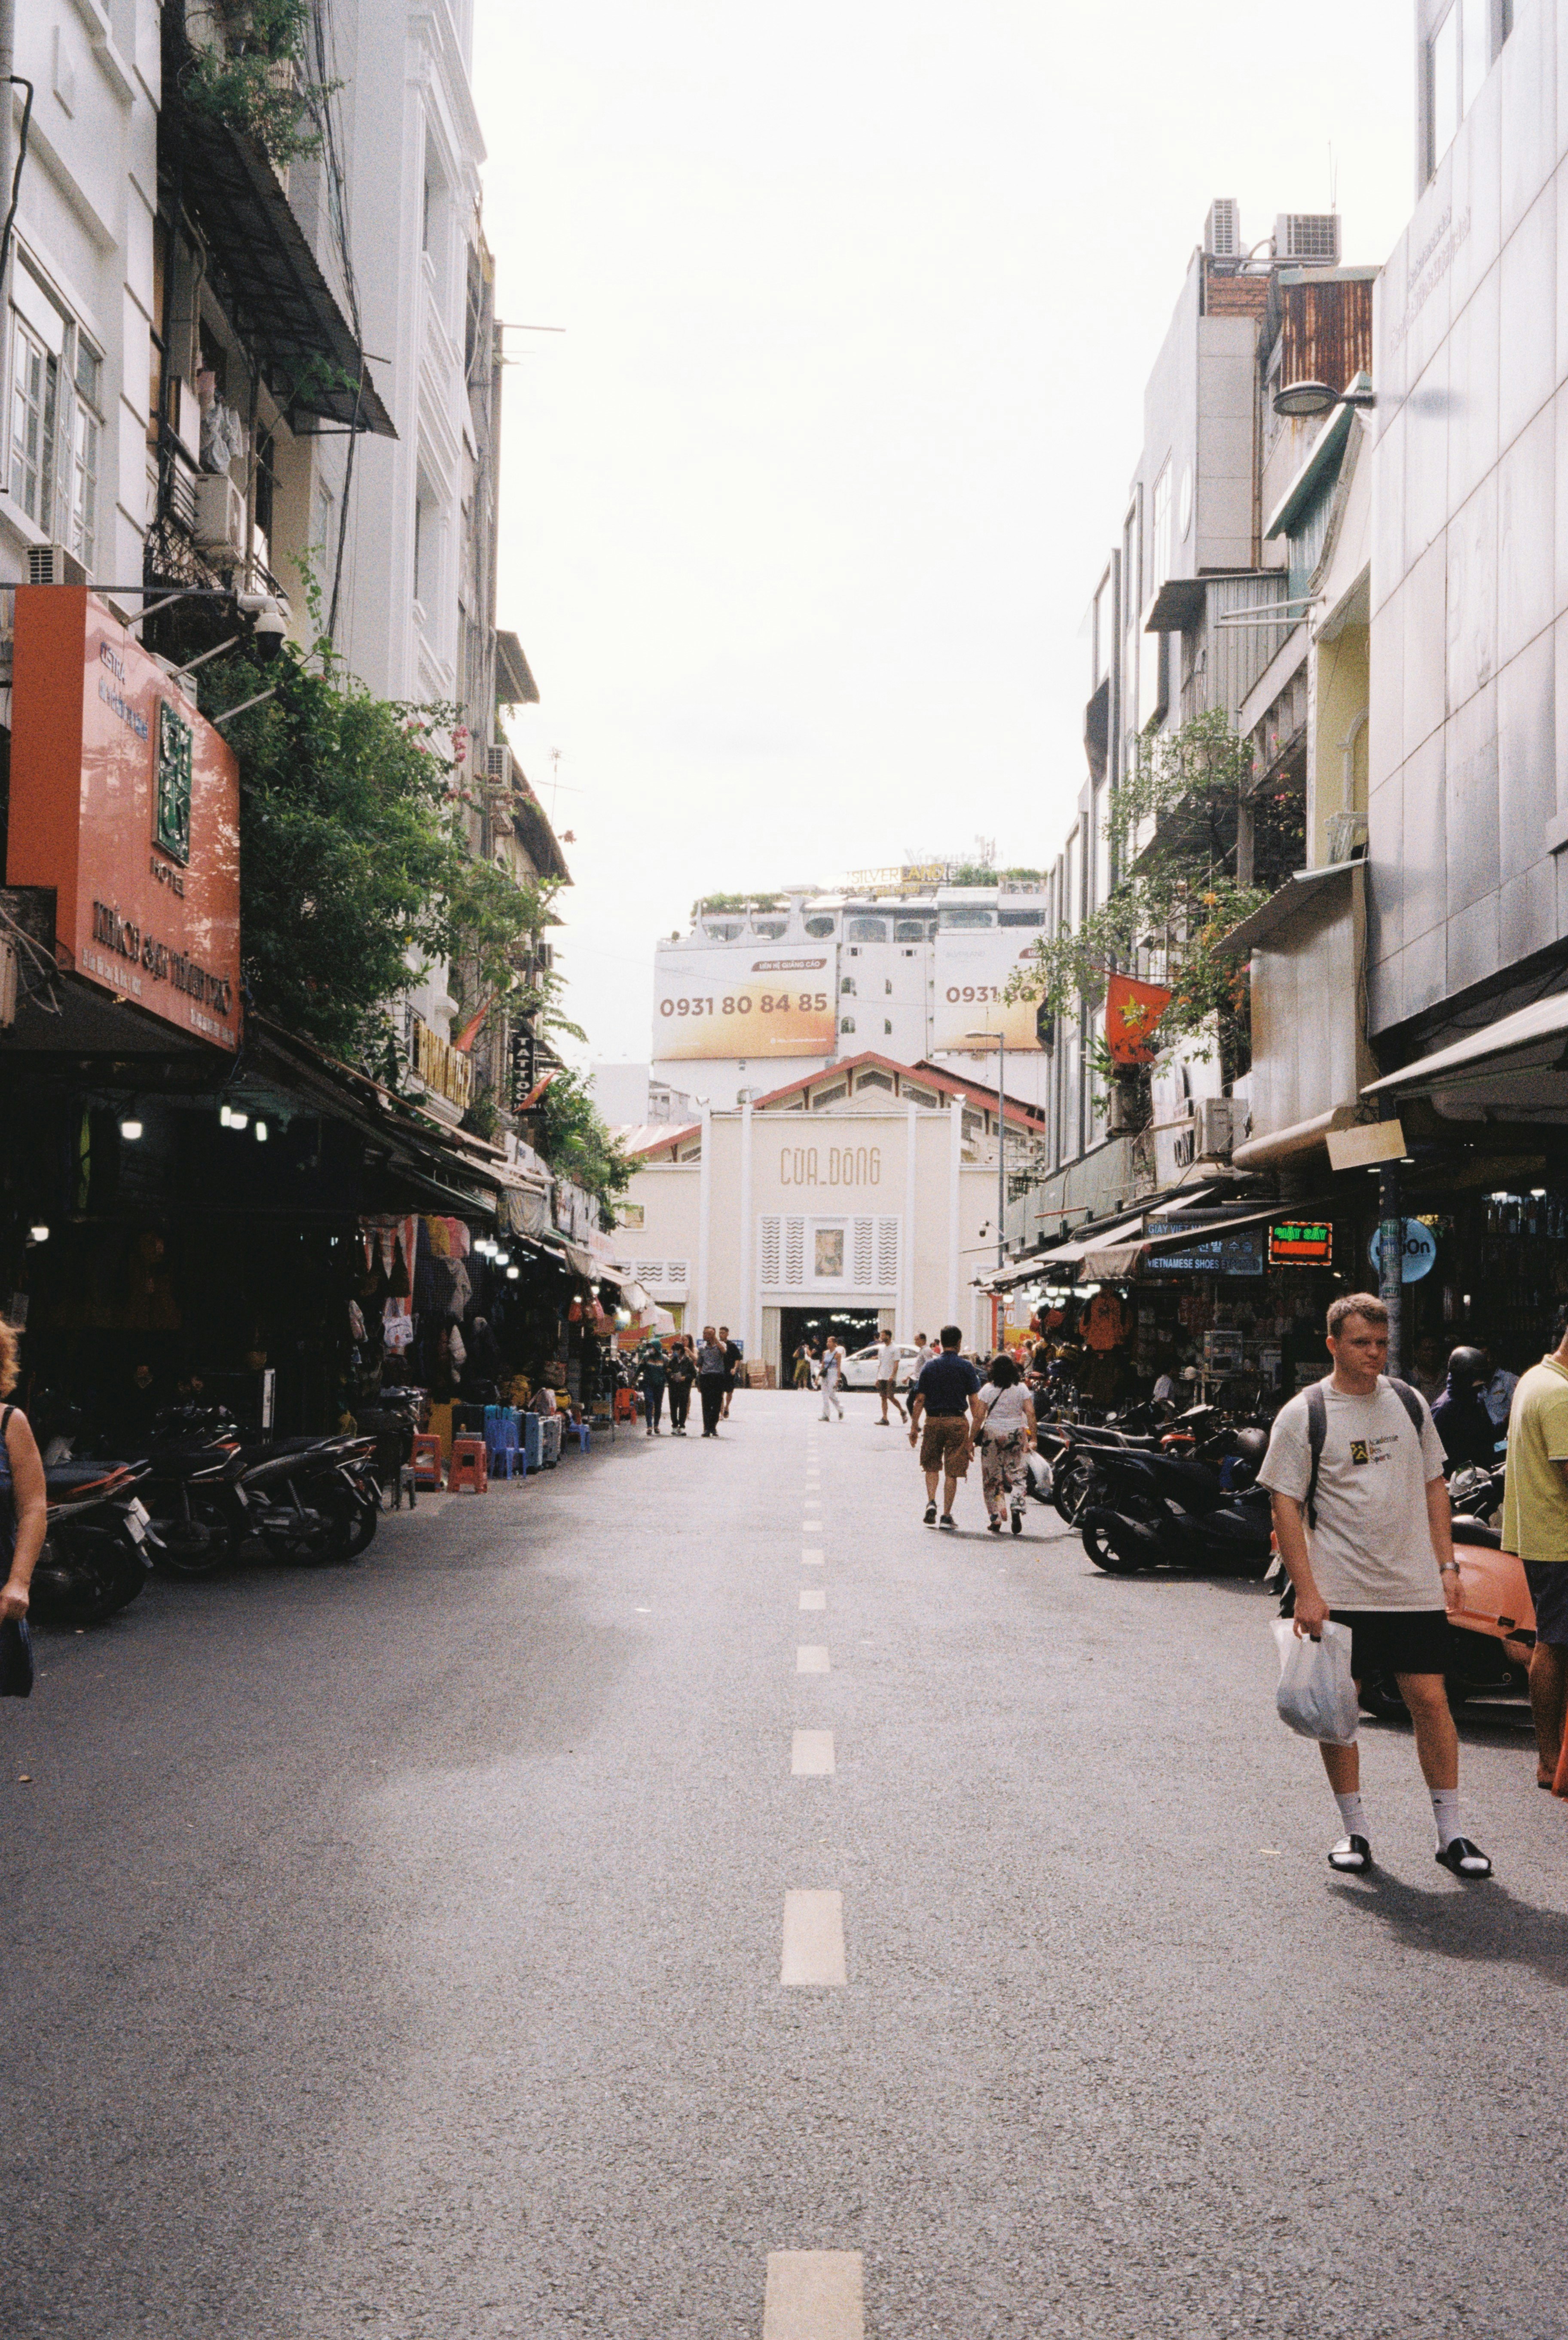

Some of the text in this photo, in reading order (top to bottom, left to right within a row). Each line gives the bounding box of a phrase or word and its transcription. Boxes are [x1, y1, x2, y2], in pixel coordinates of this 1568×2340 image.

[851, 863, 944, 884] SILVERLAND
[660, 993, 827, 1017] 0931 80 84 85
[946, 986, 997, 1003] 0931
[515, 1038, 530, 1100] TATTOO
[1147, 1258, 1193, 1268] VIETNAMESE
[1195, 1259, 1219, 1269] SHOES
